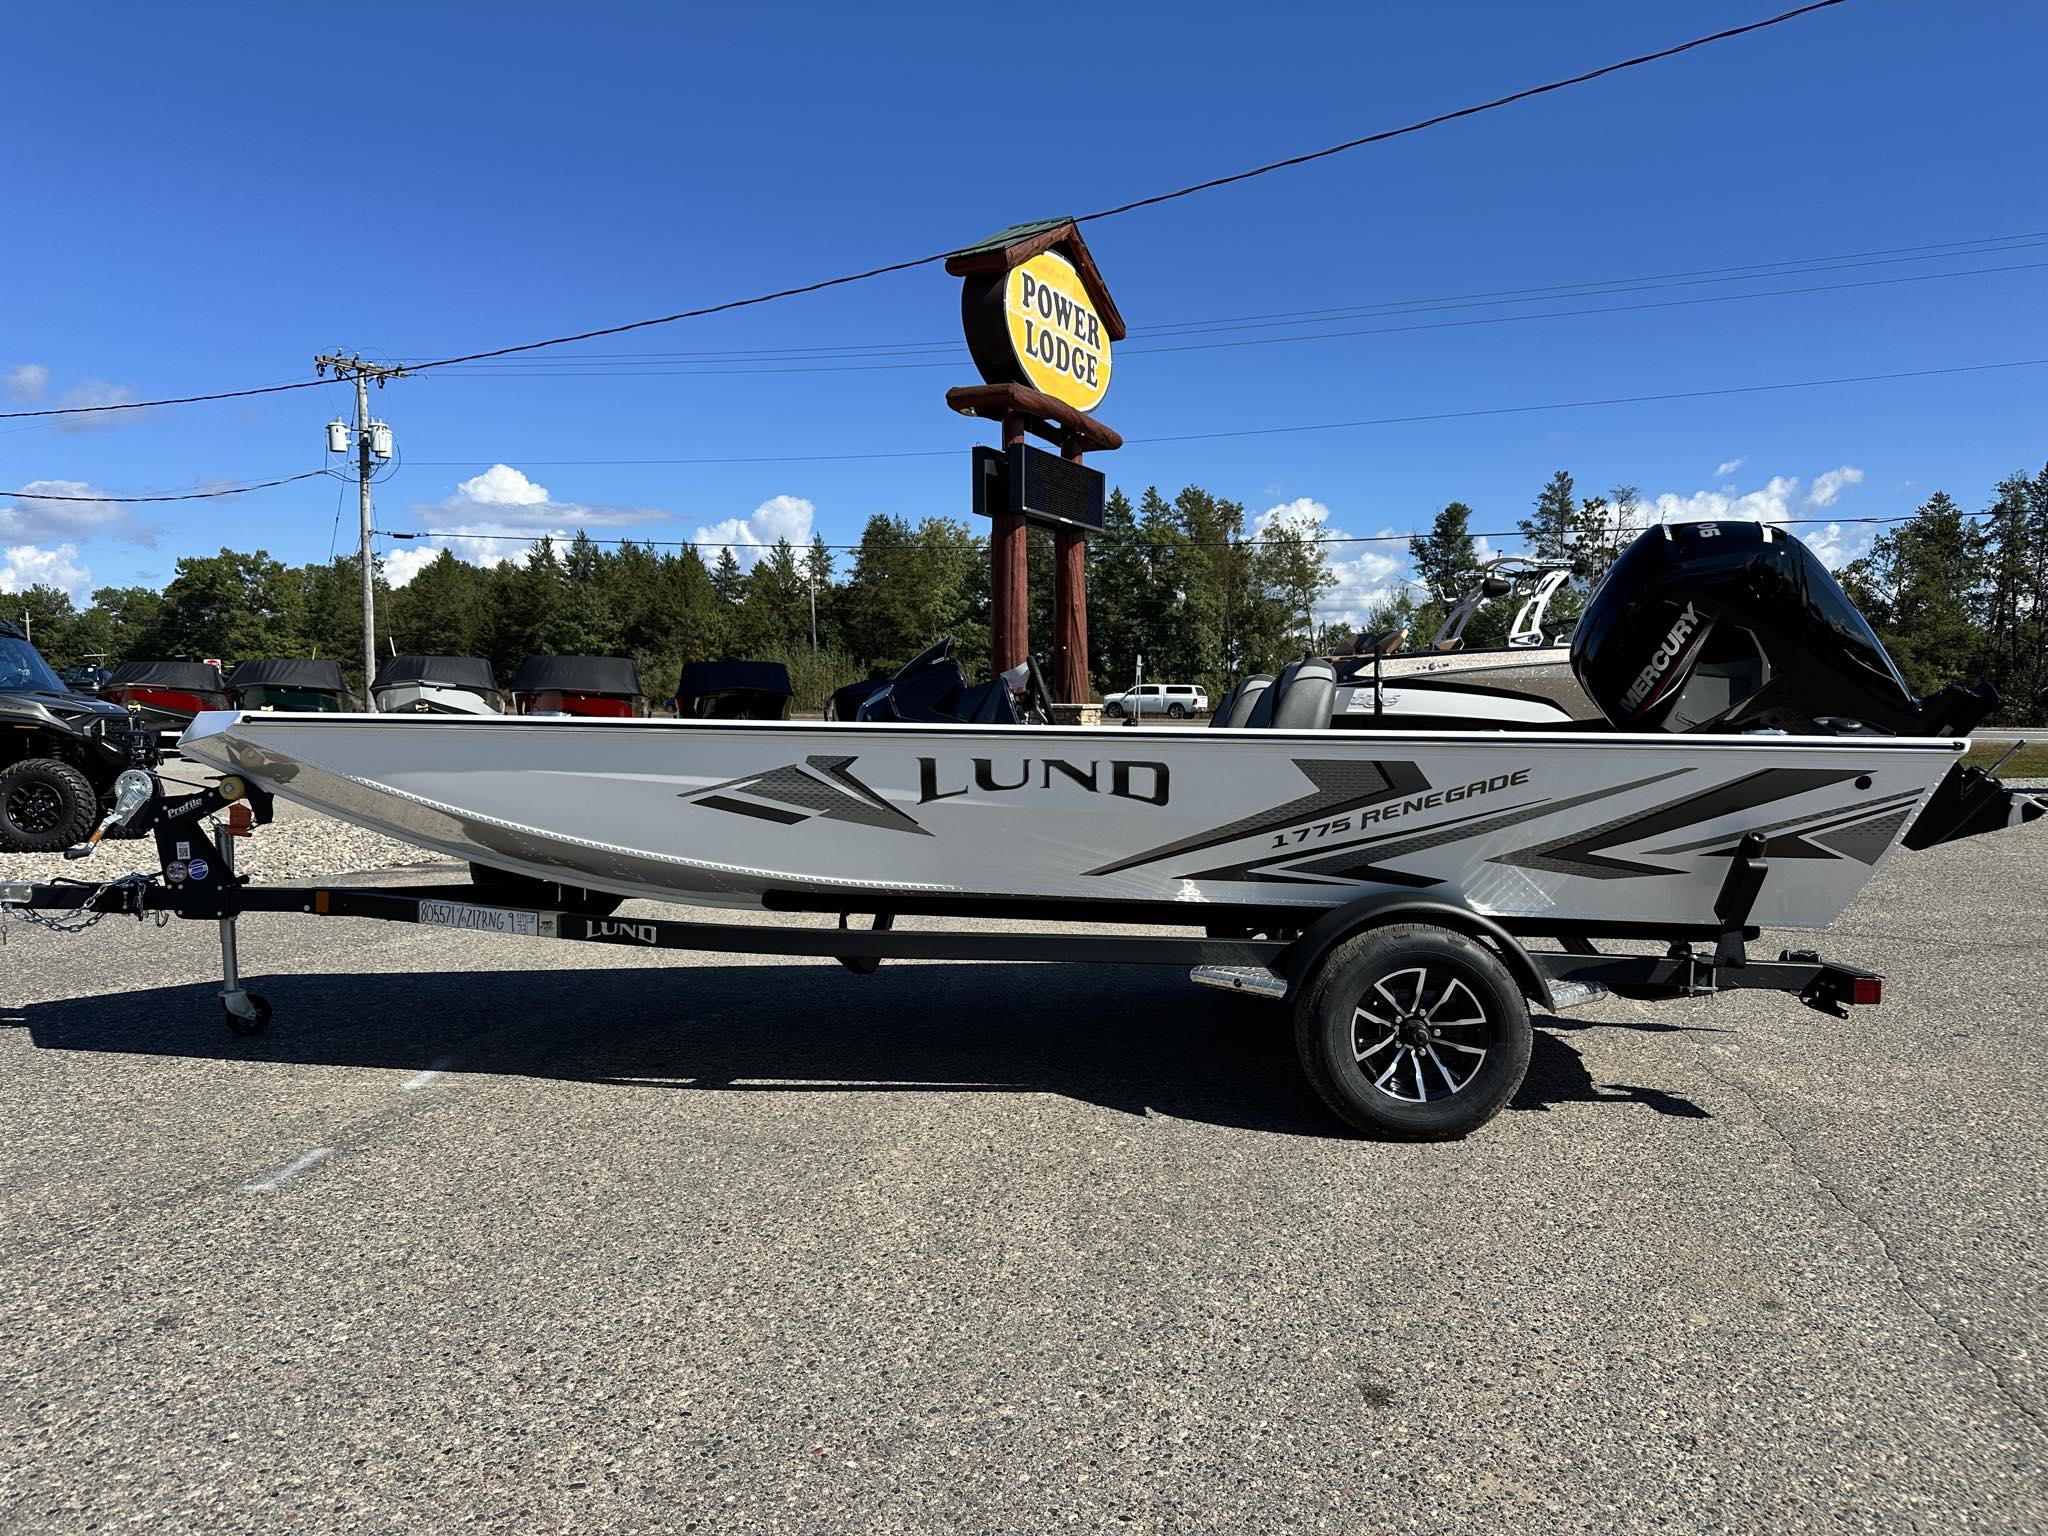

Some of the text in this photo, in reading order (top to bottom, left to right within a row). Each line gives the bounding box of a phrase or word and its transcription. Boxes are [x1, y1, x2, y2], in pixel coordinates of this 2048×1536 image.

[1022, 272, 1100, 350] POWER
[1025, 319, 1098, 389] LODGE
[1620, 601, 1698, 713] MERCURY
[167, 798, 202, 817] Profile
[915, 757, 1170, 807] LUND
[1271, 768, 1532, 849] 1775 RENEGADE
[584, 919, 657, 944] LUND
